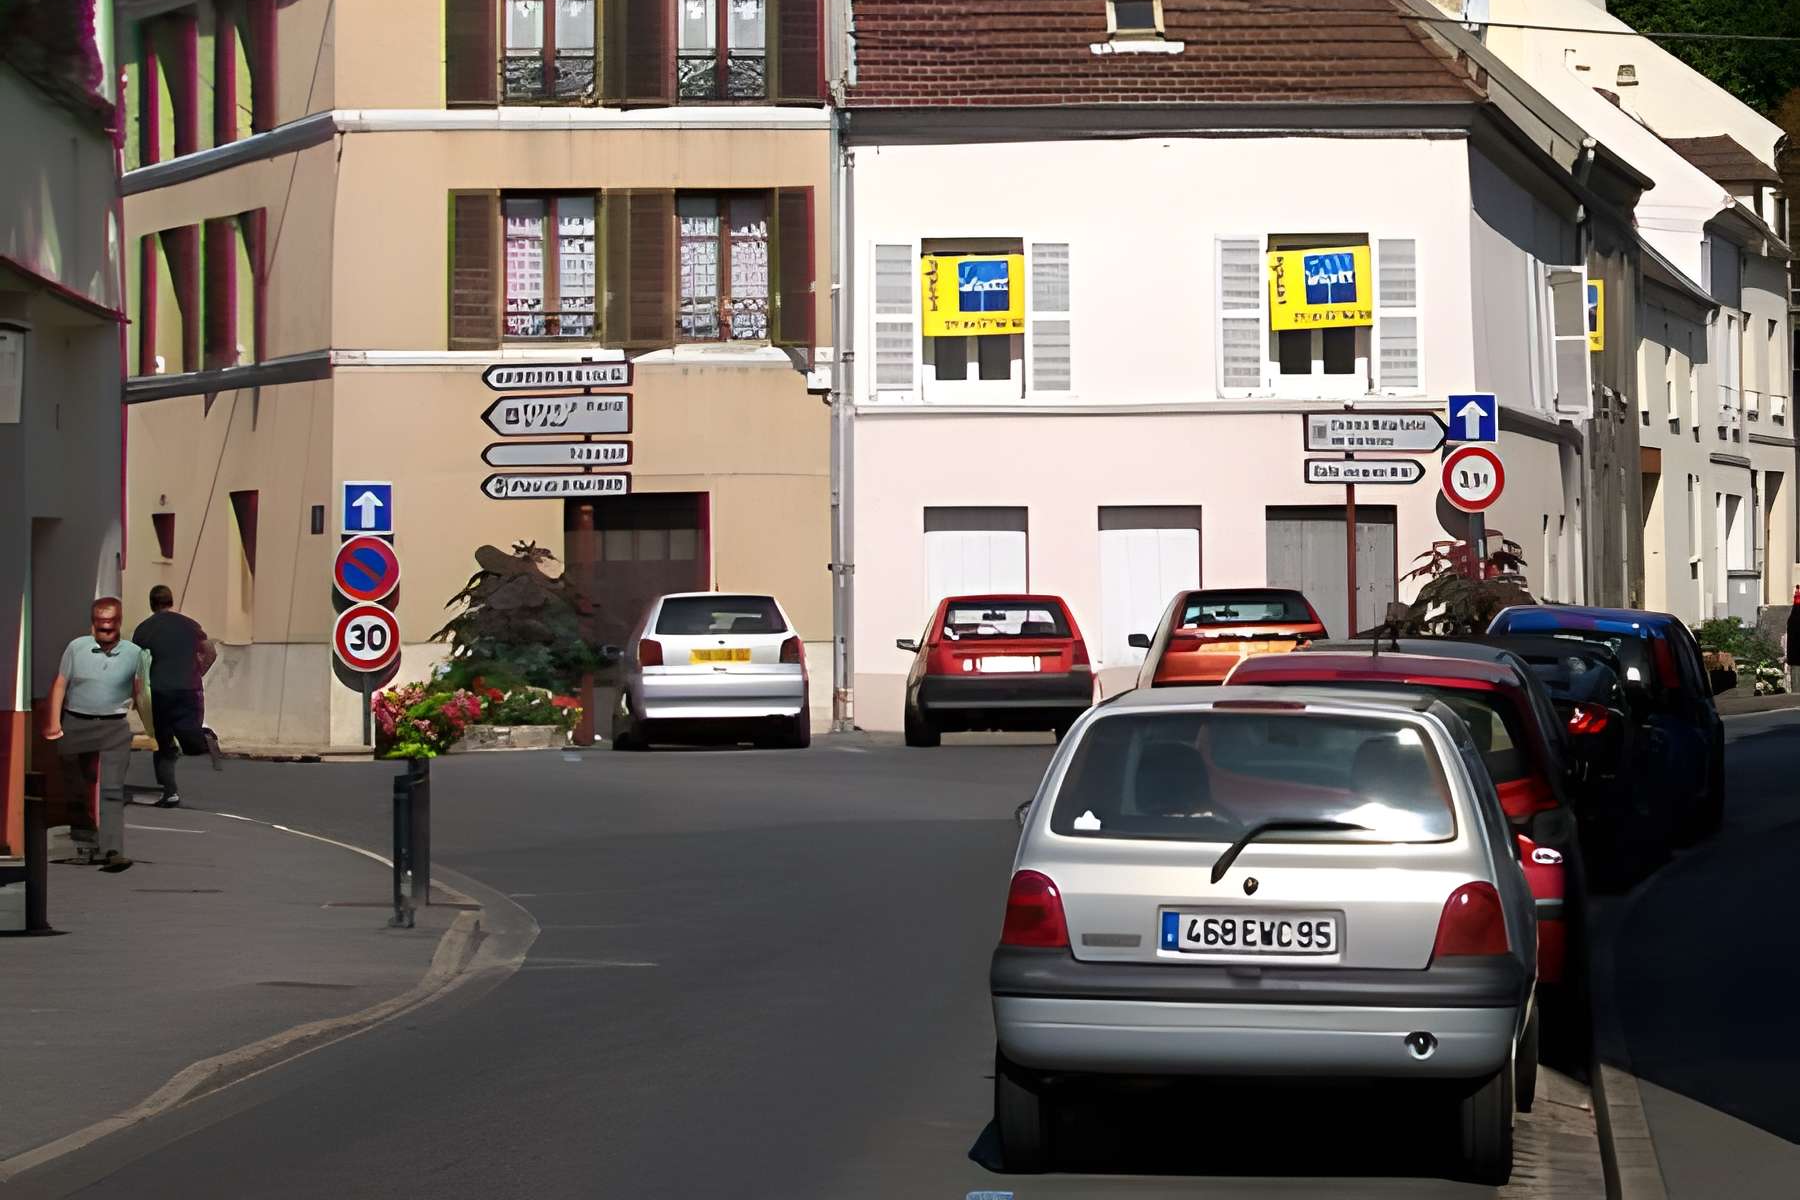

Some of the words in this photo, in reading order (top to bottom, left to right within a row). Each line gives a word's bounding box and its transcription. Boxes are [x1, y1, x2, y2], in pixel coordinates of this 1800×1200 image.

[350, 624, 387, 651] 30
[1187, 918, 1236, 946] 469
[1297, 921, 1331, 948] 95
